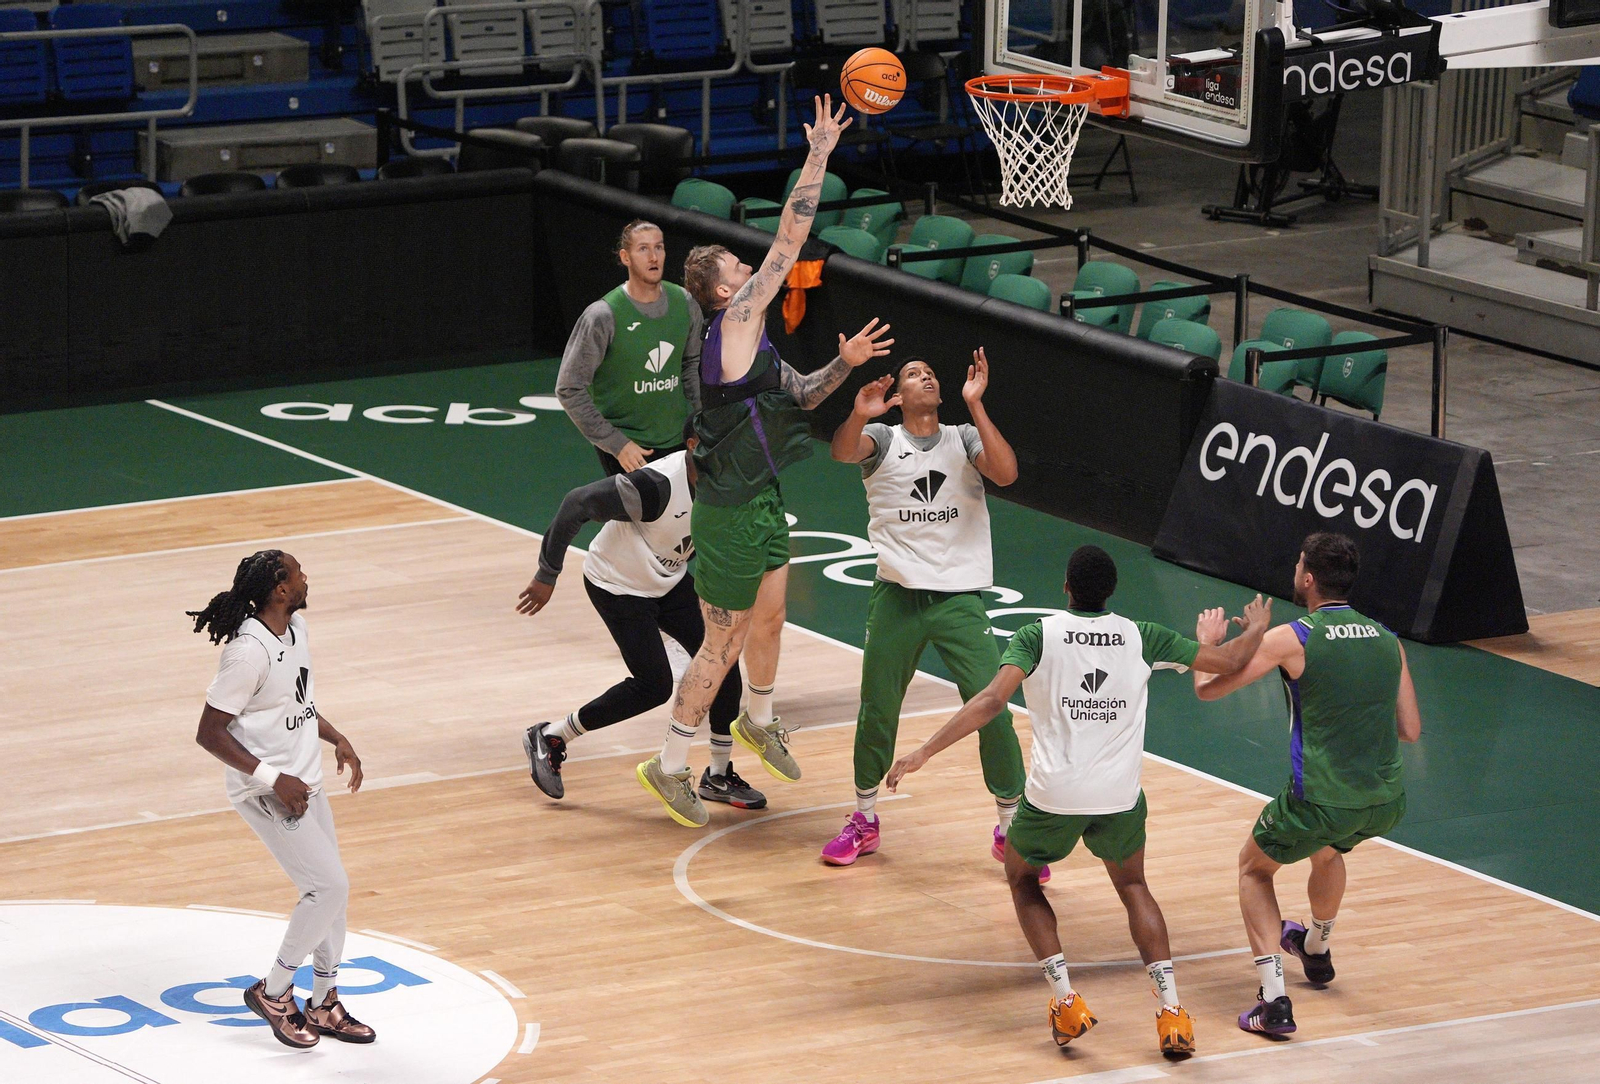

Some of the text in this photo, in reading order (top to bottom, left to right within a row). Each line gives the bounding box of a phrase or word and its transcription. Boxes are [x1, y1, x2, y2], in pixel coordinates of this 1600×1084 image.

[881, 73, 897, 82] acb
[1283, 51, 1412, 96] ndesa
[1205, 78, 1219, 92] liga
[1205, 91, 1235, 106] endesa
[633, 374, 679, 394] Unicaja
[260, 401, 537, 426] acb
[1199, 421, 1438, 543] endesa
[898, 505, 959, 524] Unicaja
[1061, 696, 1127, 709] Fundación
[1070, 708, 1117, 724] Unicaja
